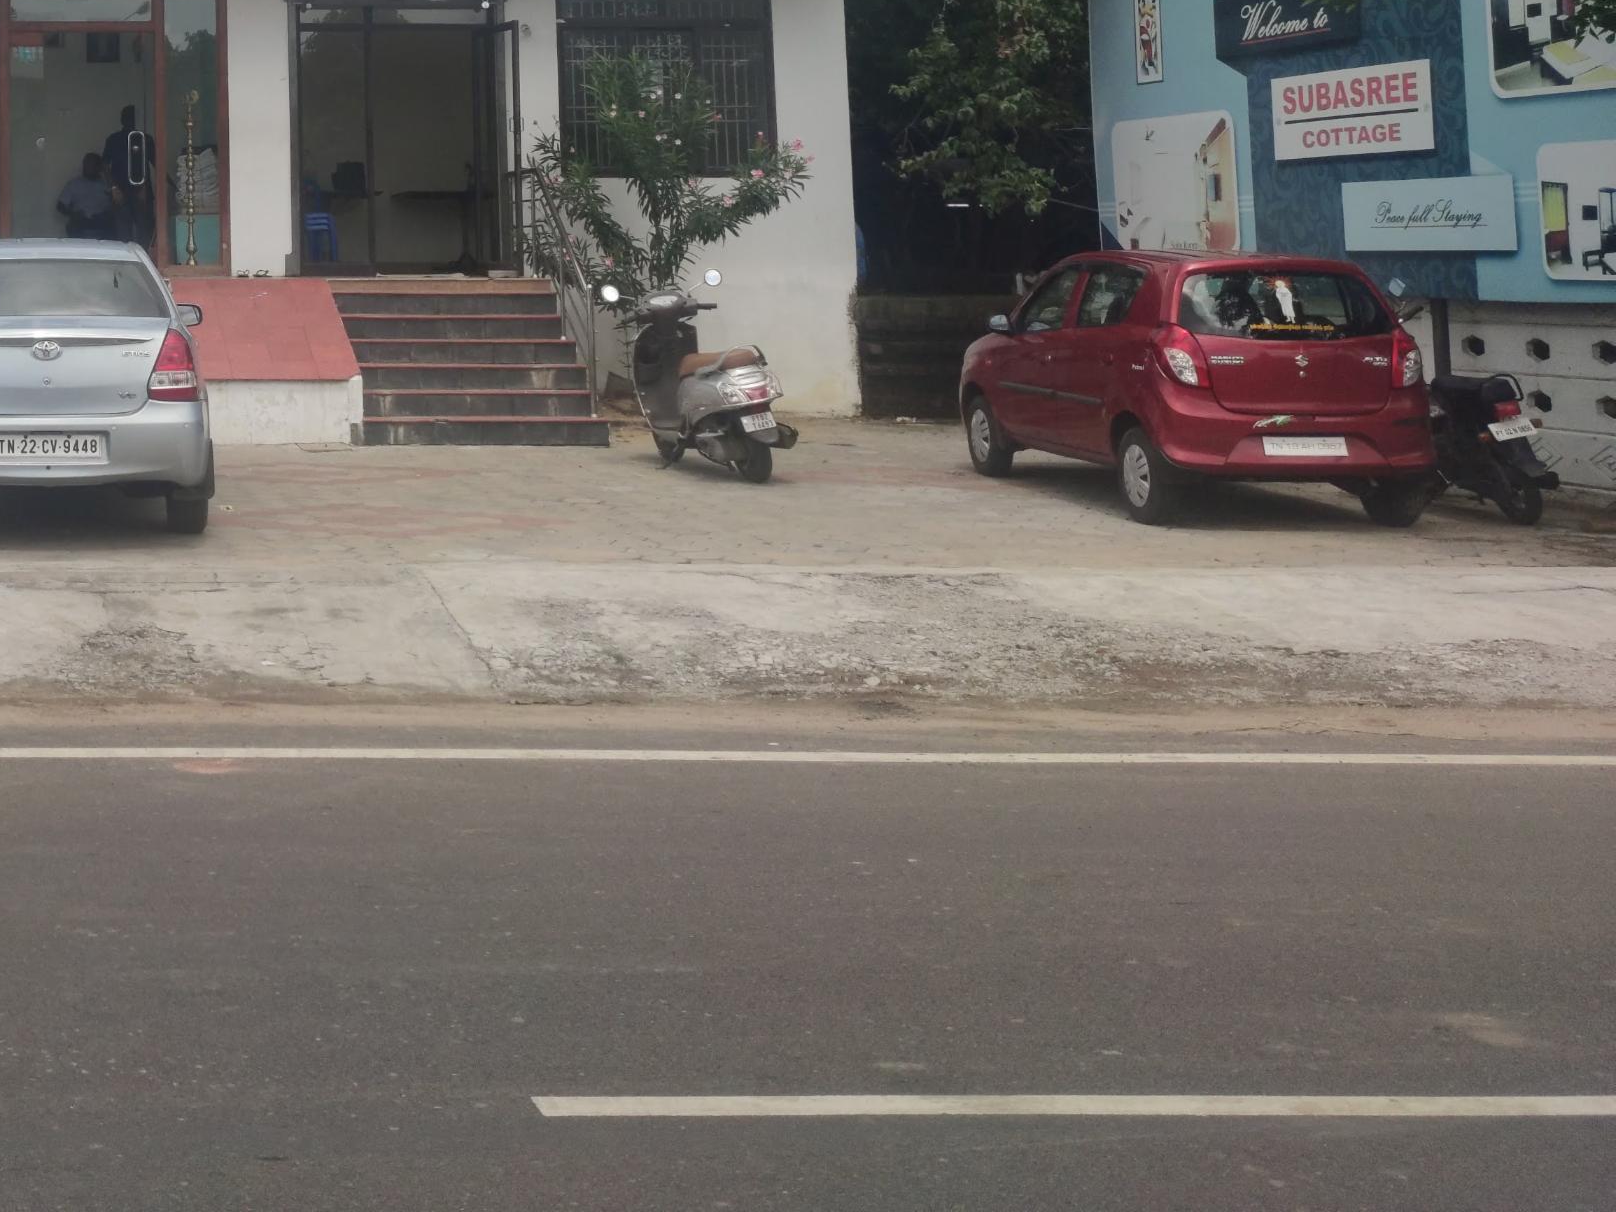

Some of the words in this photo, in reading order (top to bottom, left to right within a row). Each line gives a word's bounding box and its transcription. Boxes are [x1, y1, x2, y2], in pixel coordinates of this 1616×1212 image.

[1240, 0, 1308, 41] Welcome
[1312, 7, 1329, 28] to
[1282, 72, 1419, 115] SUBASREE
[1302, 122, 1402, 148] COTTAGE
[1375, 201, 1405, 224] Peace
[1404, 204, 1434, 230] full
[1432, 199, 1483, 229] Staying
